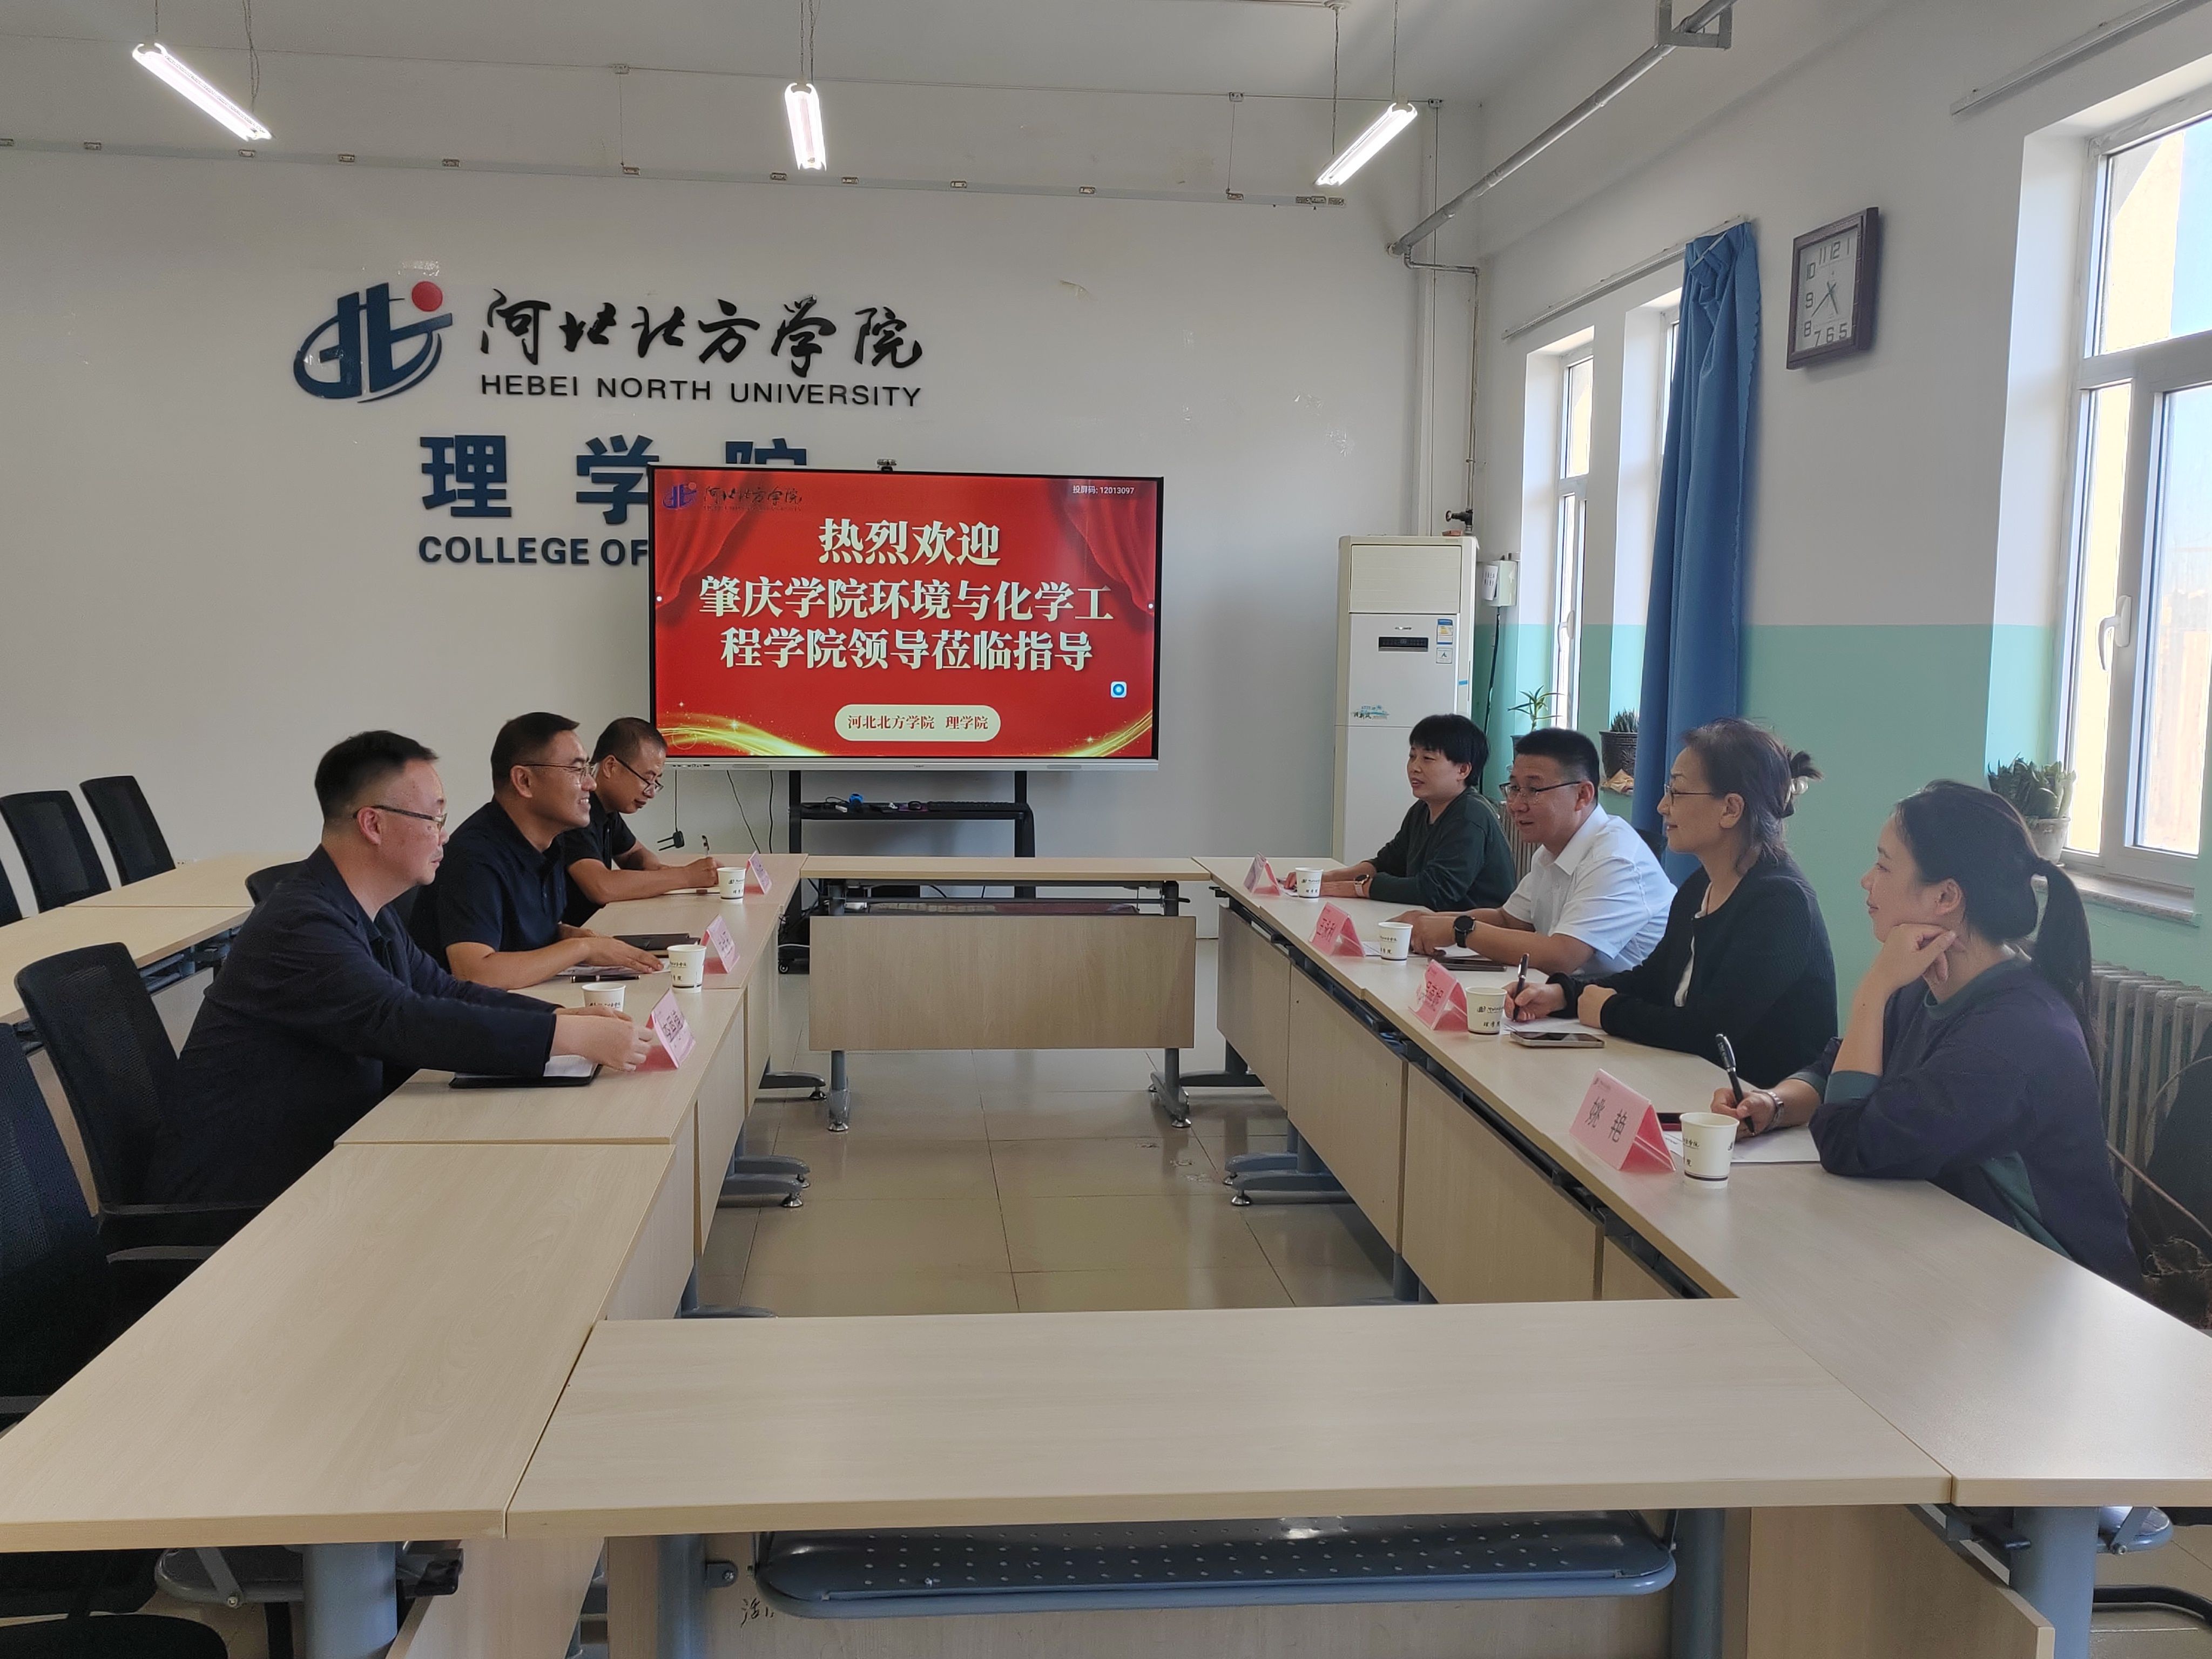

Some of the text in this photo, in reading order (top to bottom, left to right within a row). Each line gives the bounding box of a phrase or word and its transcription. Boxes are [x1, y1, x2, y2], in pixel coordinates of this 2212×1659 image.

[1818, 245, 1827, 265] 11
[1830, 240, 1841, 260] 12
[1806, 262, 1816, 282] 10
[1805, 293, 1814, 309] 9
[481, 289, 923, 377] 河北北方学院
[1804, 320, 1812, 338] 8
[1814, 331, 1821, 347] 7
[1826, 327, 1835, 343] 6
[1838, 322, 1847, 339] 5
[481, 374, 921, 407] HEBEI NORTH UNIVERSITY
[1073, 485, 1098, 494] 投屏码:
[419, 536, 648, 565] COLLEGE OF
[818, 518, 1001, 566] 热烈欢迎
[699, 575, 1114, 622] 肇庆学院环境与化学工
[720, 626, 1093, 672] 程学院领导莅临指导
[848, 714, 989, 731] 河北北方学院 理学院
